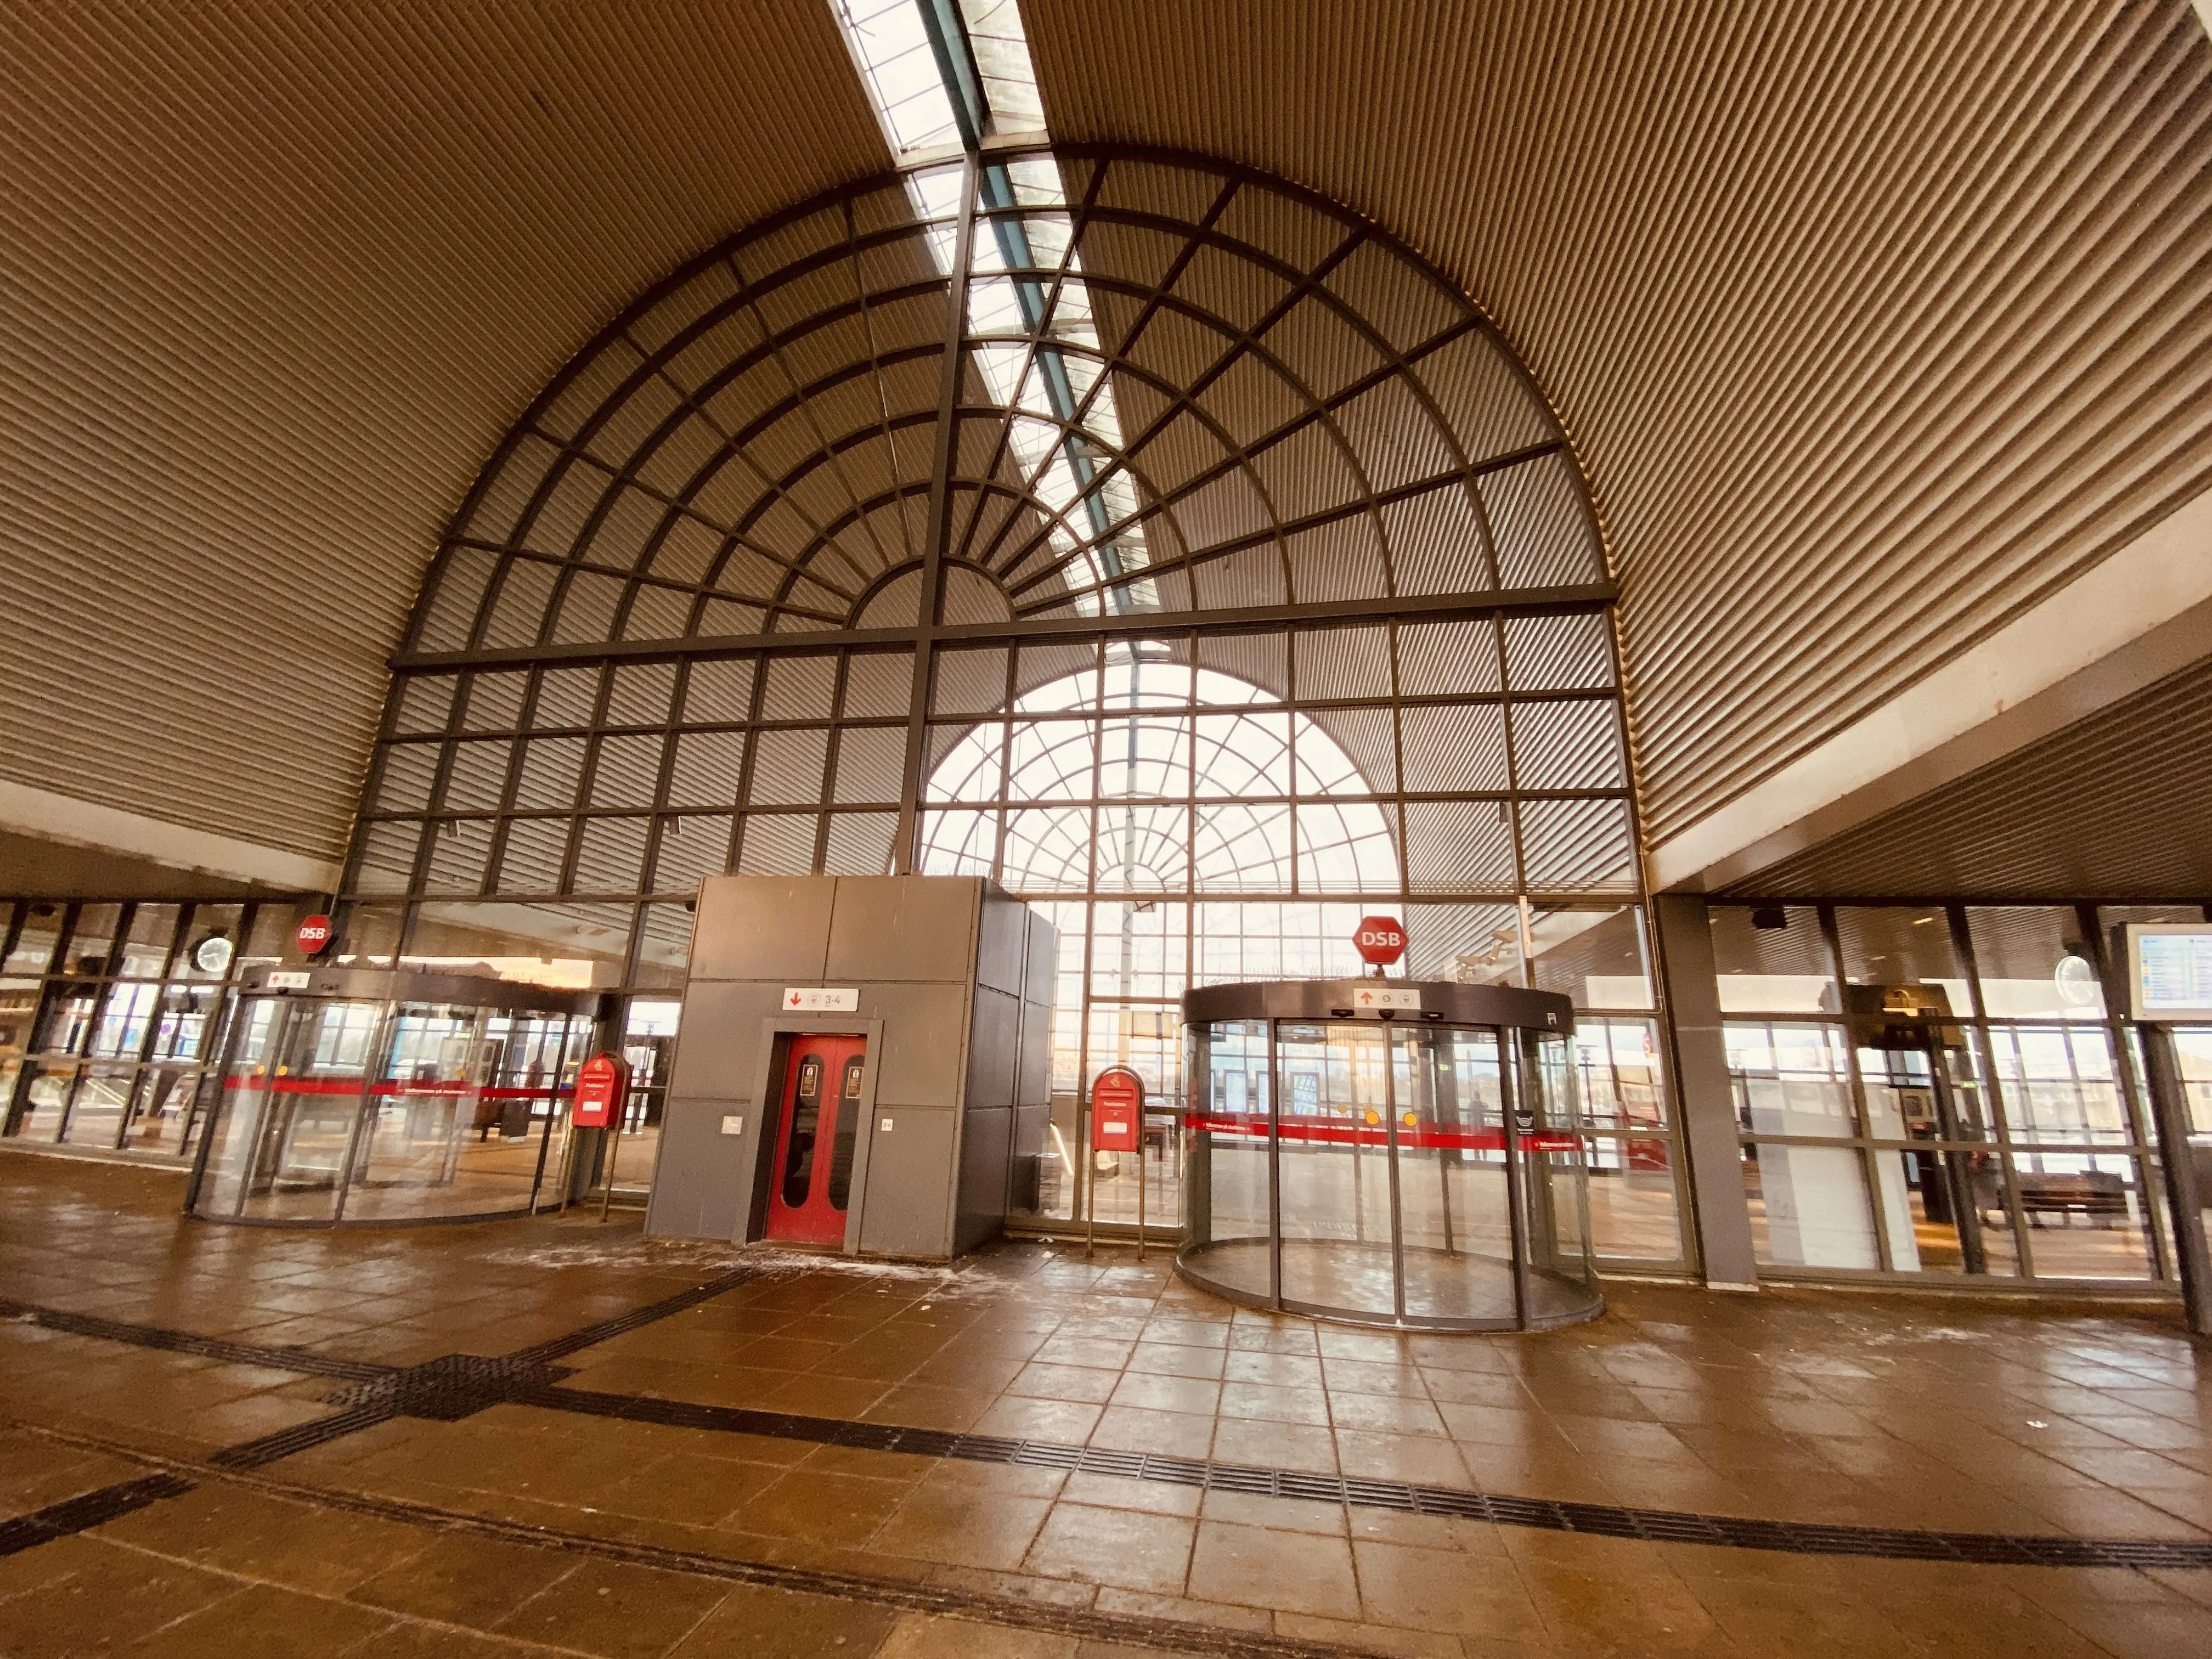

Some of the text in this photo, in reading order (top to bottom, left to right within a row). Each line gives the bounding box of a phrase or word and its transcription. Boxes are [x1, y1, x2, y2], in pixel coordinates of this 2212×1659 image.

[300, 927, 325, 939] DSB
[1362, 932, 1401, 946] DSB
[826, 995, 840, 1004] 3-4
